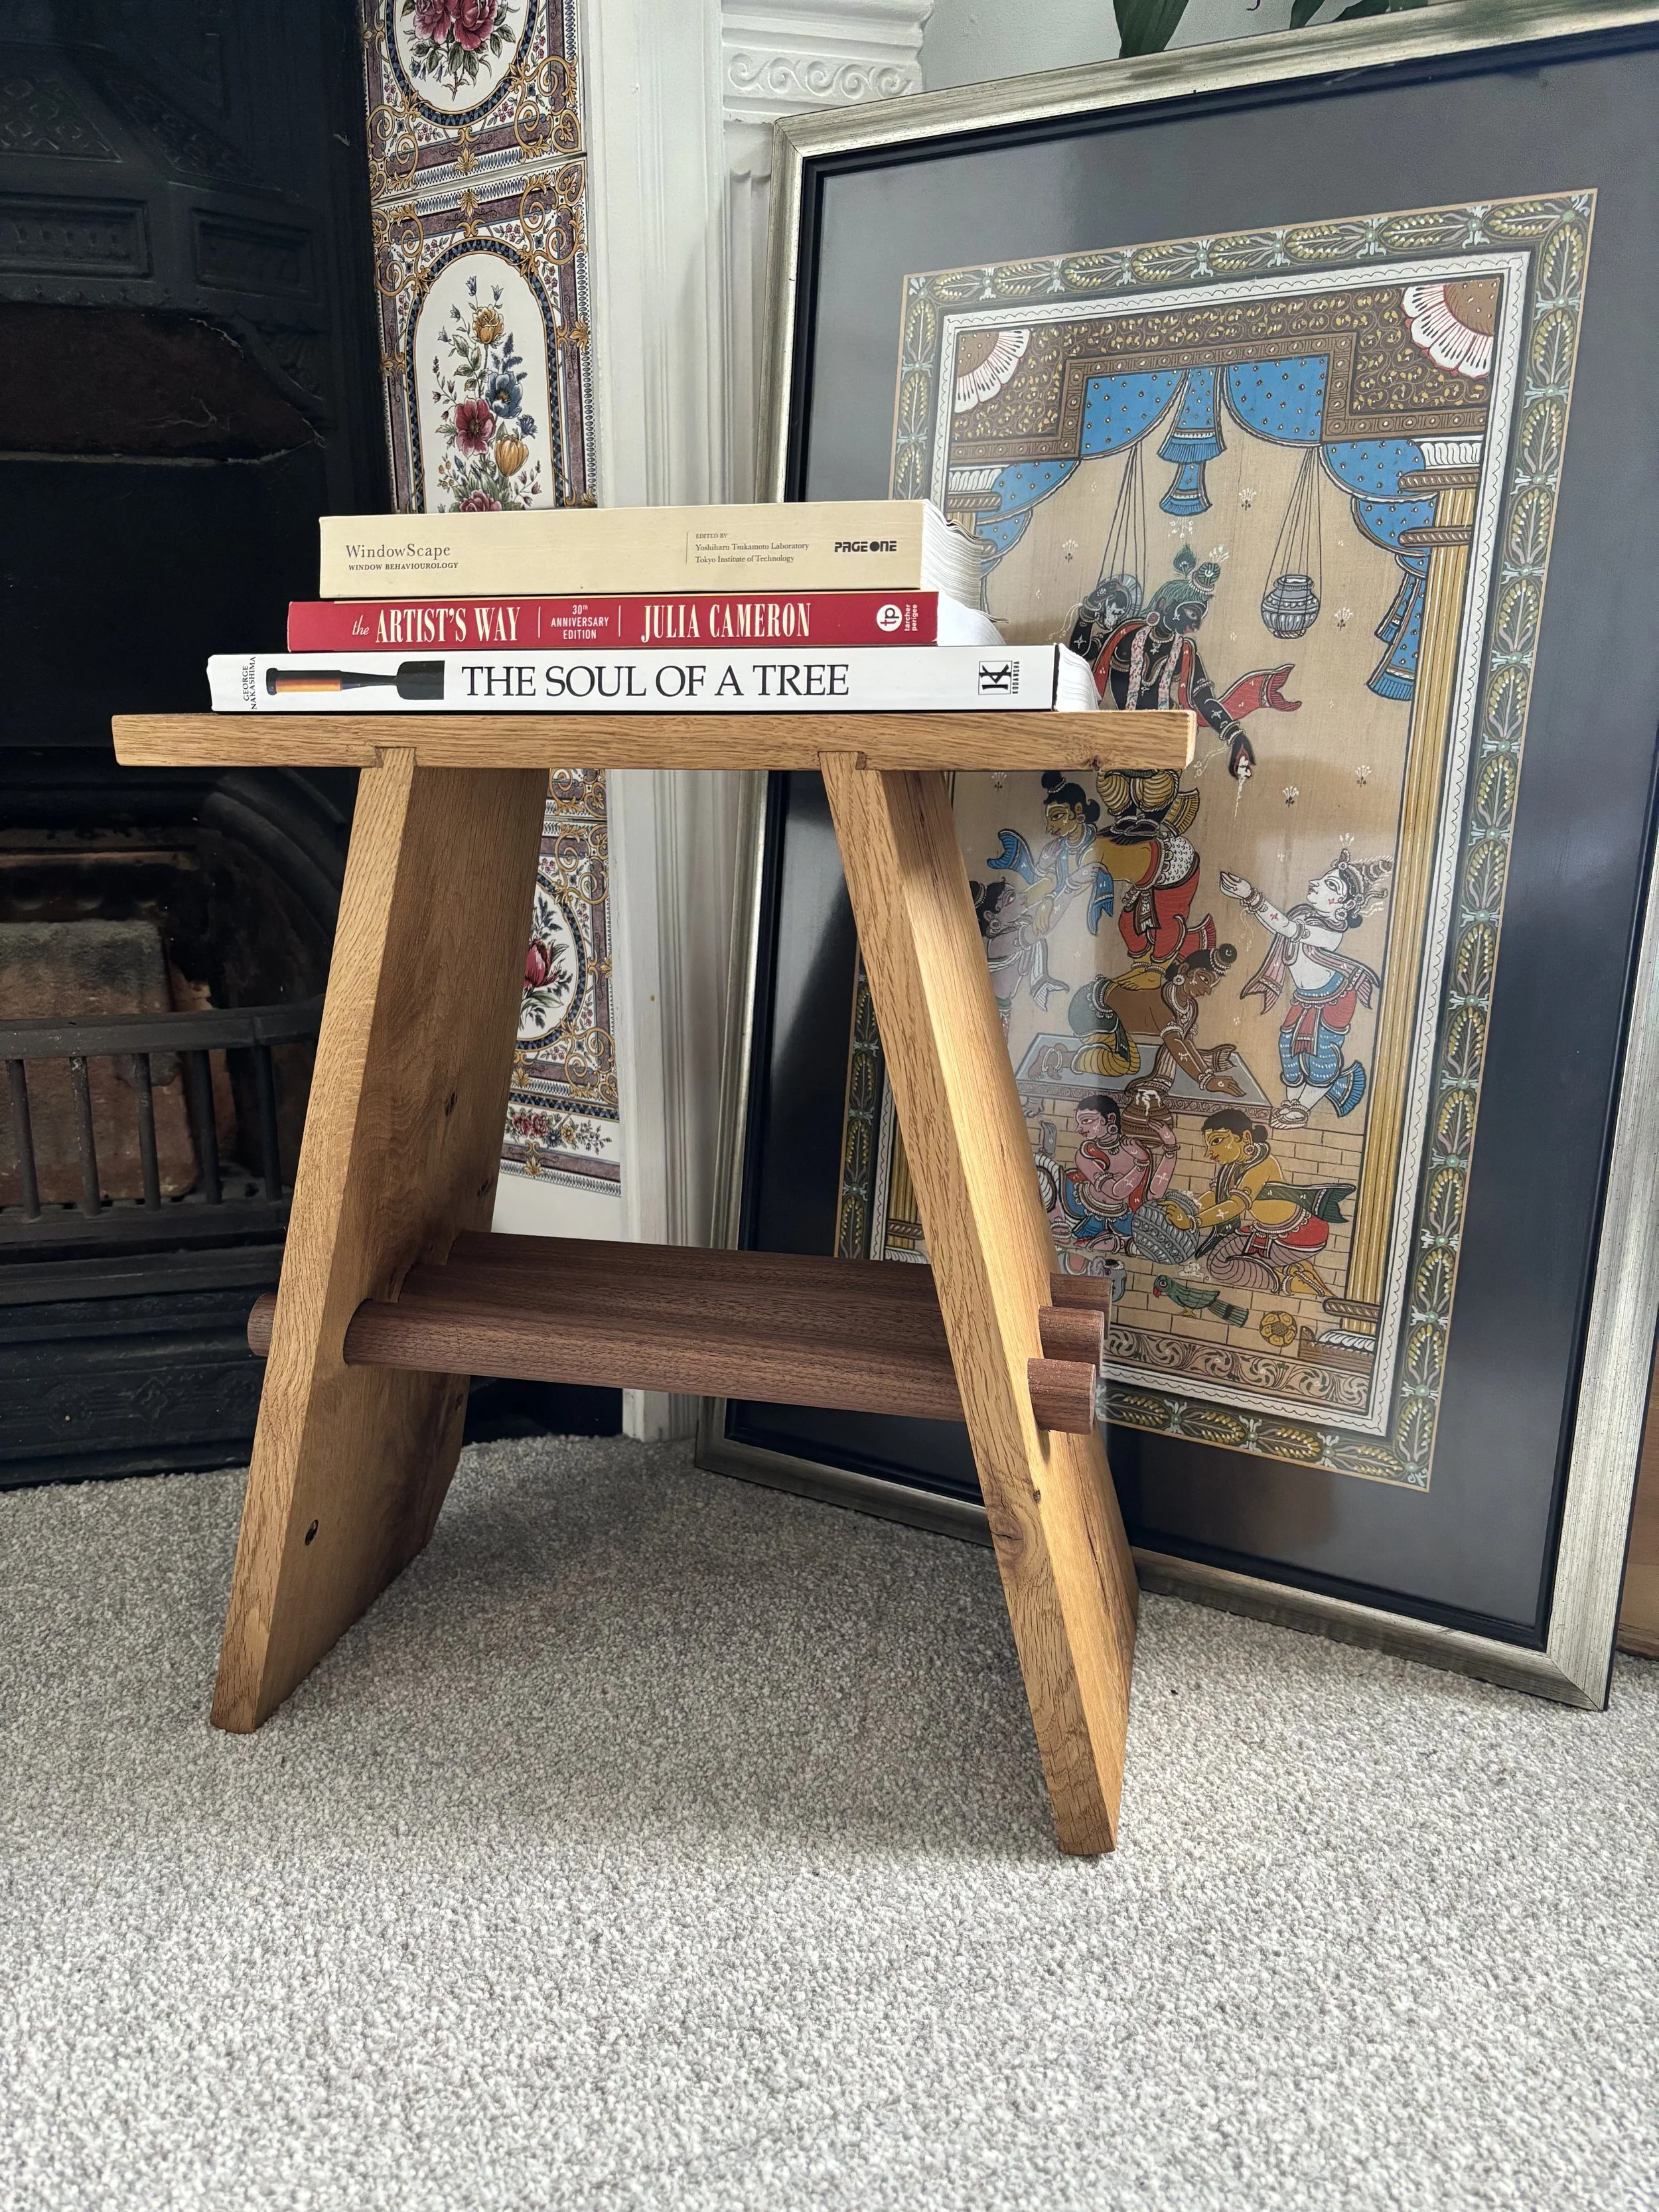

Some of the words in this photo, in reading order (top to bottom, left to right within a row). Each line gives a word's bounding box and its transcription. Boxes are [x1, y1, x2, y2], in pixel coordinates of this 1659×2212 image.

[346, 543, 451, 560] WindowScape
[551, 617, 609, 627] ANNIVERSARY
[572, 605, 589, 615] 30th
[641, 604, 701, 642] JULIA
[709, 603, 812, 637] CAMERON
[352, 615, 370, 636] the
[375, 607, 467, 643] ARTIST'S
[474, 607, 520, 642] WAY
[563, 629, 597, 639] EDITION
[249, 656, 257, 709] NAKASHIMA
[461, 666, 536, 696] THE
[545, 665, 646, 697] SOUL
[655, 665, 706, 696] OF
[714, 664, 744, 696] A
[753, 664, 849, 696] TREE
